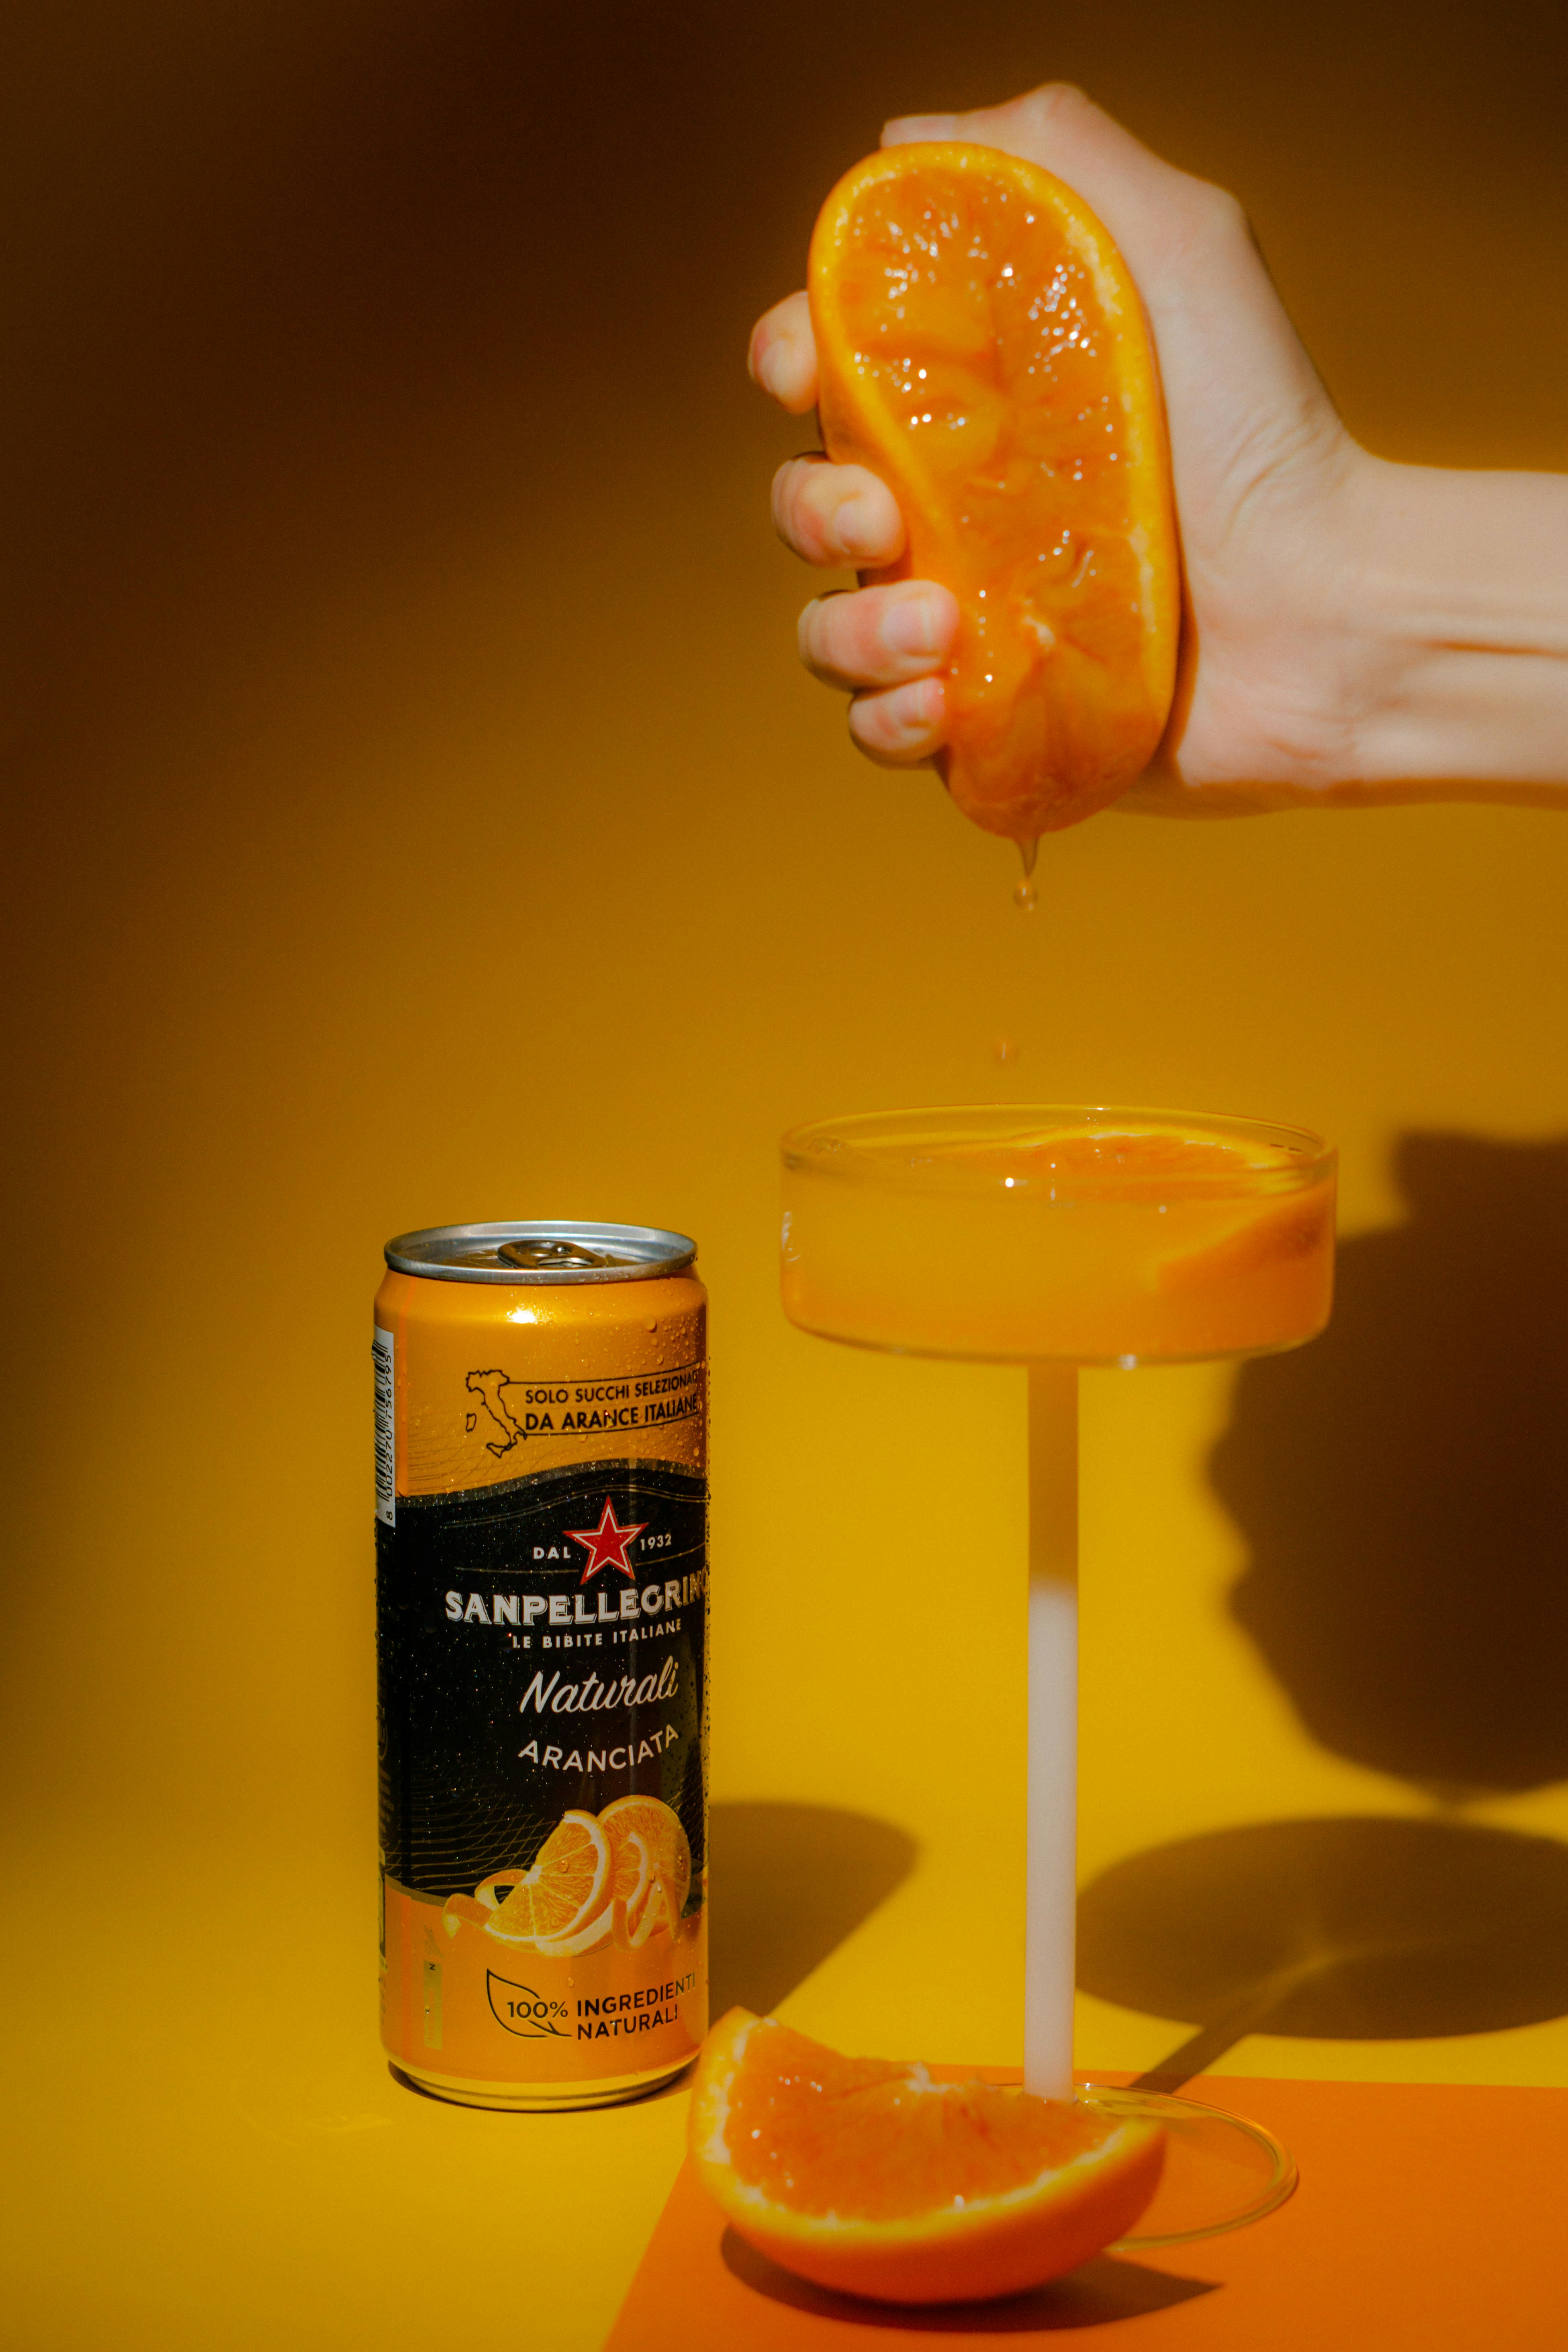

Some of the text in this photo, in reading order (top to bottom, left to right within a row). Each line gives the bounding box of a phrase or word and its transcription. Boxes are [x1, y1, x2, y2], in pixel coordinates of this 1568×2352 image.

[525, 1388, 568, 1404] SOLO
[575, 1385, 630, 1402] SUCCHI
[525, 1393, 697, 1431] DA ARANCE ITALIANE
[386, 1511, 393, 1520] 8
[533, 1533, 672, 1560] DAL 1932
[512, 1618, 682, 1648] LE BIBITE ITALIANE
[519, 1655, 679, 1714] Naturali
[517, 1724, 679, 1773] ARANCIATA
[507, 1972, 695, 2019] 100% INGREDIENTI
[577, 2004, 678, 2040] NATURALI
